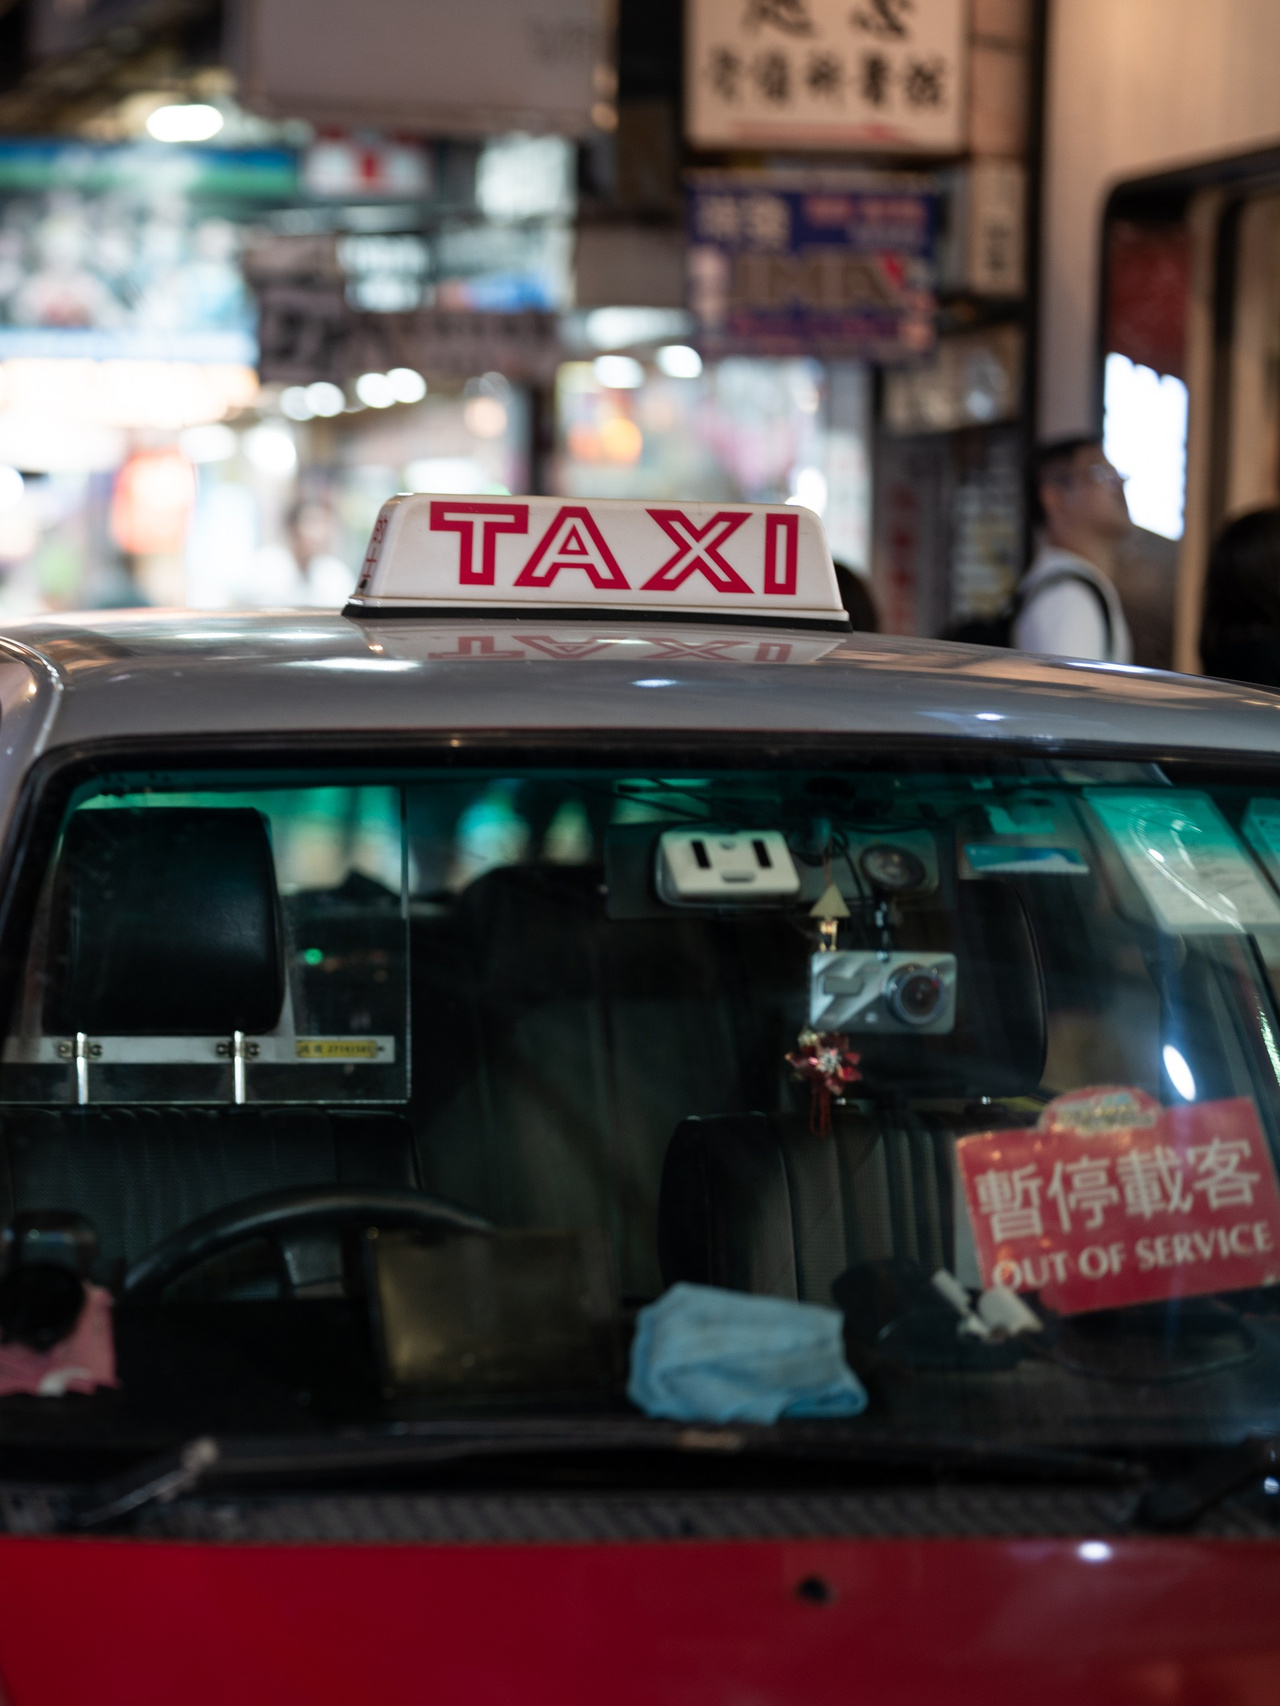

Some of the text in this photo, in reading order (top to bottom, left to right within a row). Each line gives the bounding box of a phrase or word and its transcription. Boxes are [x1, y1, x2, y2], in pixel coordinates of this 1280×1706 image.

[429, 501, 800, 595] TAXI
[975, 1138, 1260, 1242] 暫停載客
[992, 1220, 1273, 1290] OUT OF SERVICE
